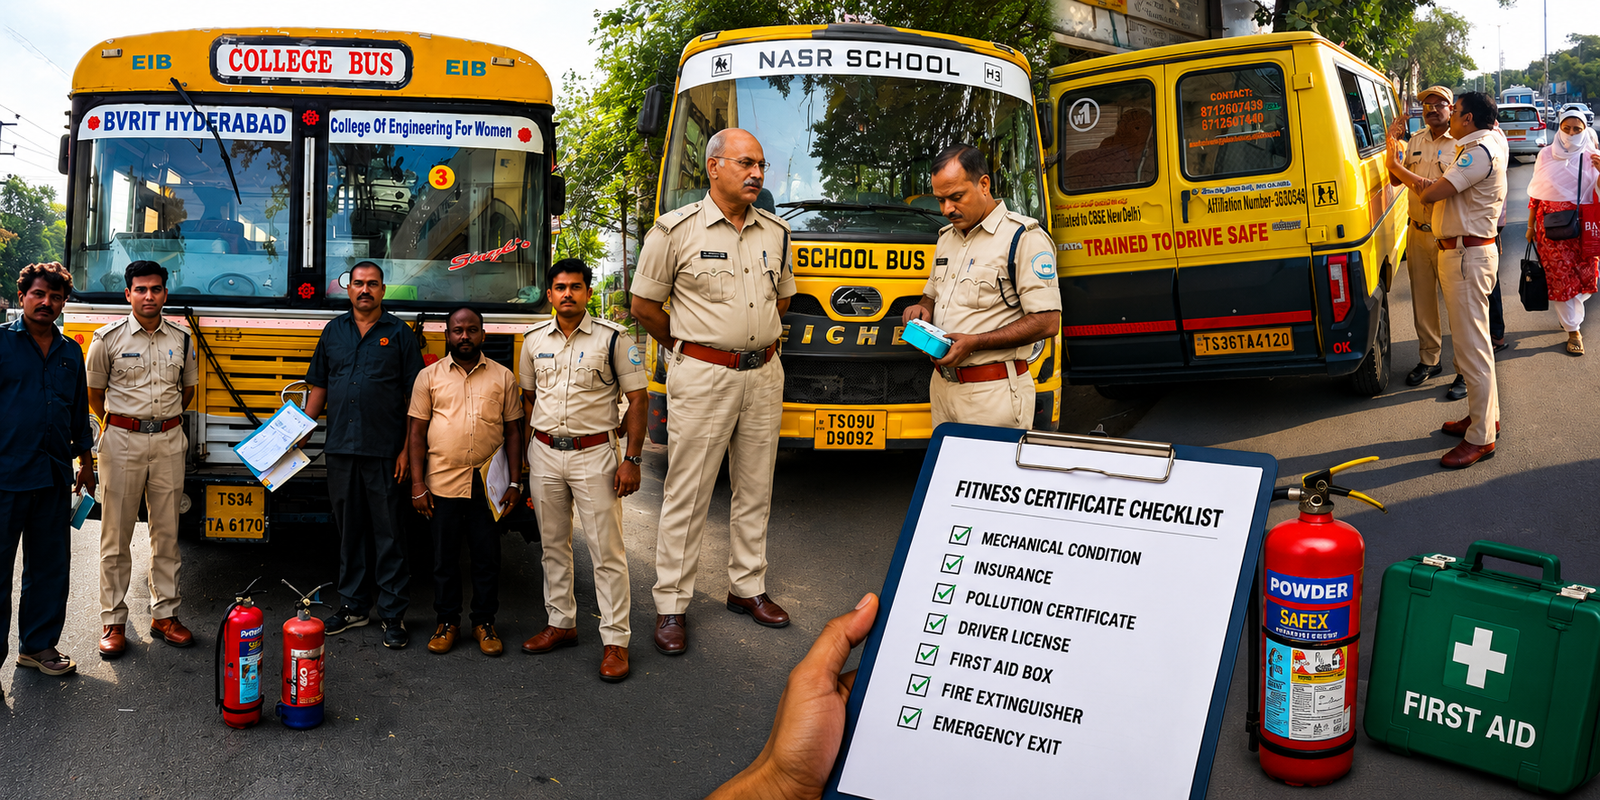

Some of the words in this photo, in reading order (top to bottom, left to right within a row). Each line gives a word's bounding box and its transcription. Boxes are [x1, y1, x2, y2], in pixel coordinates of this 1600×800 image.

[132, 54, 172, 70] EIB
[229, 48, 332, 73] COLLEGE
[349, 51, 394, 76] BUS
[445, 59, 486, 77] EIB
[758, 48, 832, 69] NASR
[846, 49, 960, 77] SCHOOL
[986, 68, 1001, 83] H3
[104, 111, 161, 131] BVRIT
[165, 112, 286, 134] HYDERABAD
[330, 117, 371, 135] College
[374, 117, 387, 134] Of
[389, 118, 452, 139] Engineering
[454, 120, 473, 137] For
[474, 121, 512, 138] Women
[435, 169, 447, 186] 3
[1084, 234, 1148, 257] TRAINED
[1152, 232, 1173, 251] TO
[1177, 227, 1222, 249] DRIVE
[1227, 222, 1269, 243] SAFE
[797, 247, 879, 270] SCHOOL
[886, 250, 925, 271] BUS
[1203, 332, 1290, 352] TS36TA4120
[1333, 341, 1352, 354] OK
[828, 414, 874, 428] TS09U
[827, 431, 873, 445] D9092
[217, 492, 253, 506] TS34
[955, 480, 1021, 504] FITNESS
[1024, 487, 1126, 517] CERTIFICATE
[1129, 499, 1224, 528] CHECKLIST
[207, 518, 224, 532] TA
[229, 518, 263, 532] 6170
[981, 532, 1064, 556] MECHANICAL
[1067, 543, 1142, 566] CONDITION
[974, 560, 1053, 585] INSURANCE
[1270, 576, 1348, 599] POWDER
[965, 590, 1044, 616] POLLUTION
[1046, 602, 1136, 630] CERTIFICATE
[1280, 609, 1329, 629] SAFEX
[957, 621, 1009, 642] DRIVER
[1011, 630, 1071, 653] LICENSE
[949, 651, 992, 672] FIRST
[993, 660, 1019, 677] AID
[1022, 665, 1053, 684] BOX
[941, 682, 974, 702] FIRE
[976, 690, 1084, 725] EXTINGUISHER
[1403, 690, 1481, 733] FIRST
[1485, 714, 1536, 749] AID
[932, 714, 1025, 748] EMERGENCY
[1027, 736, 1062, 756] EXIT
